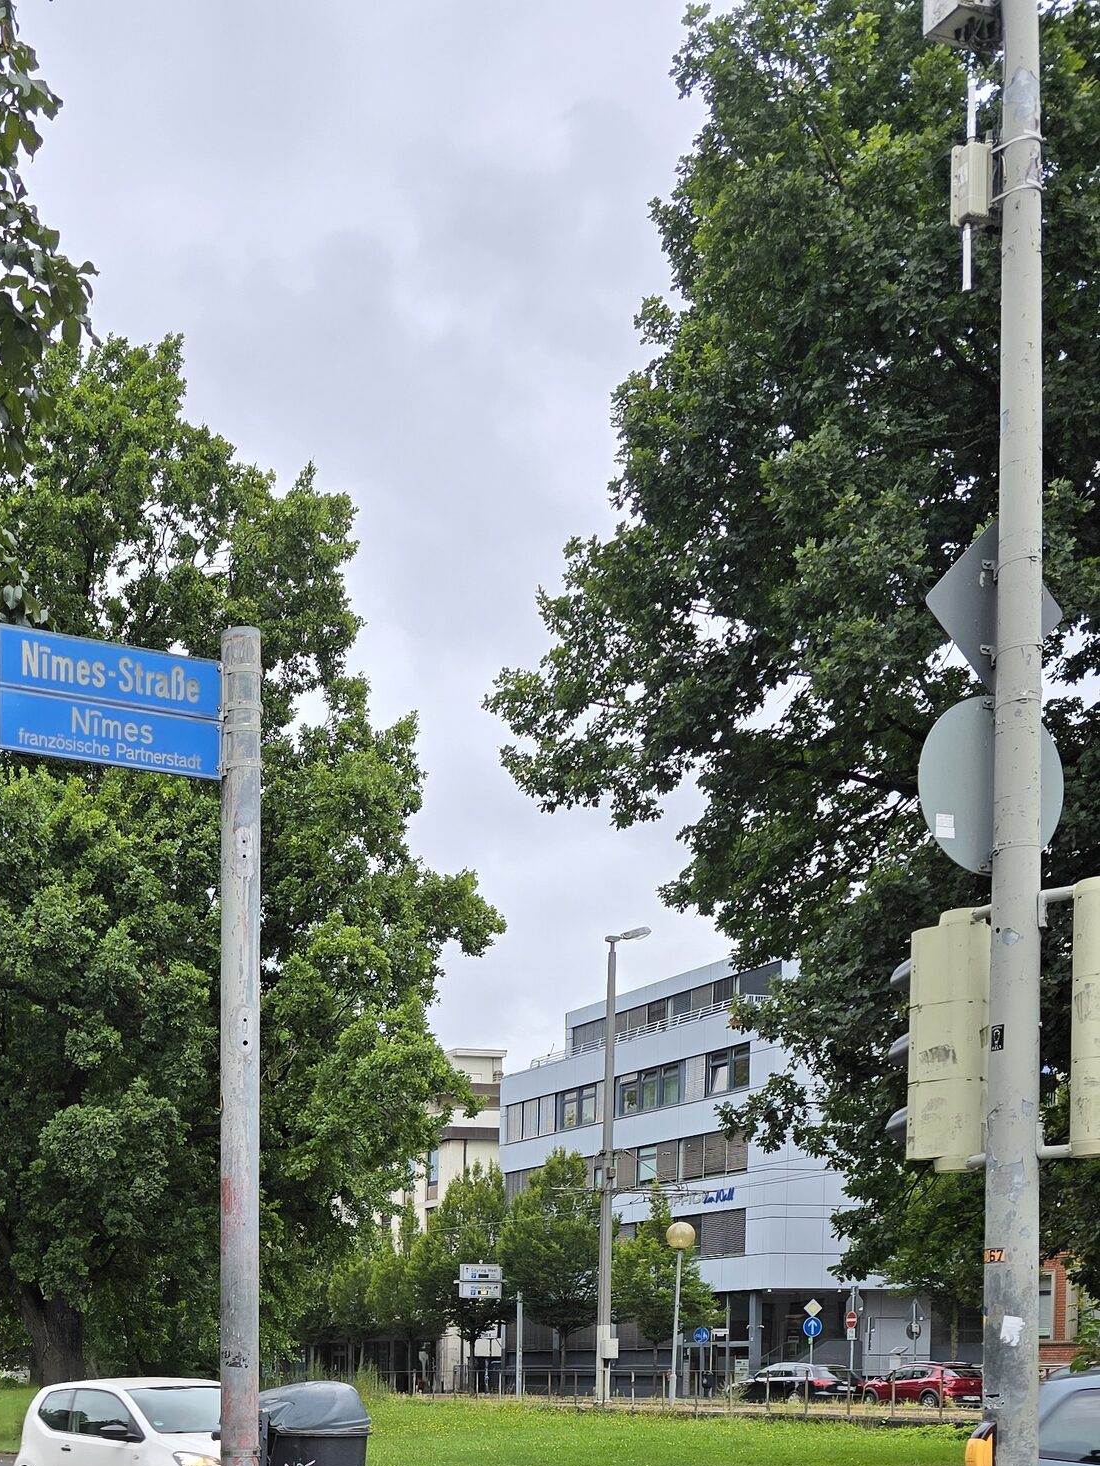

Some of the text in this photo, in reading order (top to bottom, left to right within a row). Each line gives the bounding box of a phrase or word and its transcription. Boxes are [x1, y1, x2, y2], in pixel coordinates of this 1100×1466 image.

[21, 639, 200, 703] Nîmes-Straße
[71, 706, 154, 744] Nîmes
[18, 729, 202, 770] französische Partnerstadt
